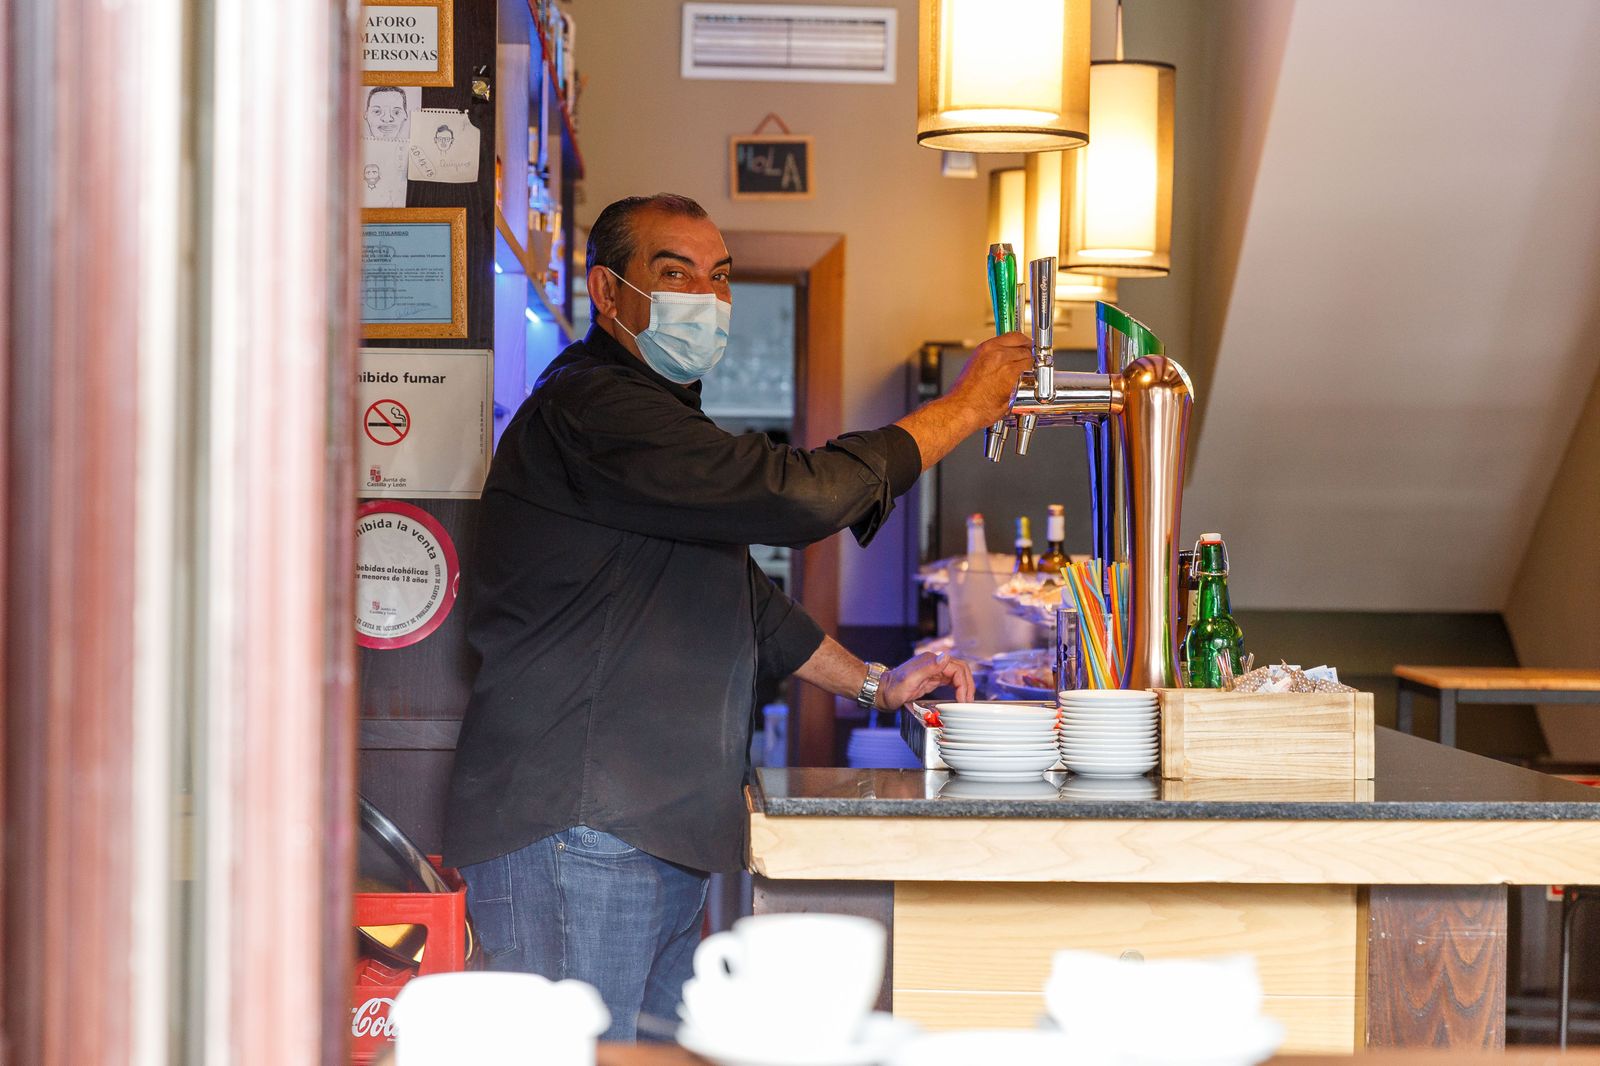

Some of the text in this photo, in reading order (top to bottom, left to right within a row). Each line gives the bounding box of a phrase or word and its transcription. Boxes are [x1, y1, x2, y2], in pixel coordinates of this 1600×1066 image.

[365, 16, 416, 28] AFORO
[363, 49, 438, 61] PERSONAS
[356, 372, 447, 384] hibido fumar
[355, 518, 437, 560] hibida la venta
[355, 564, 429, 576] bebidas alcohólicas
[361, 574, 390, 582] menores
[391, 574, 400, 582] de
[402, 575, 411, 583] 18
[411, 575, 428, 584] años
